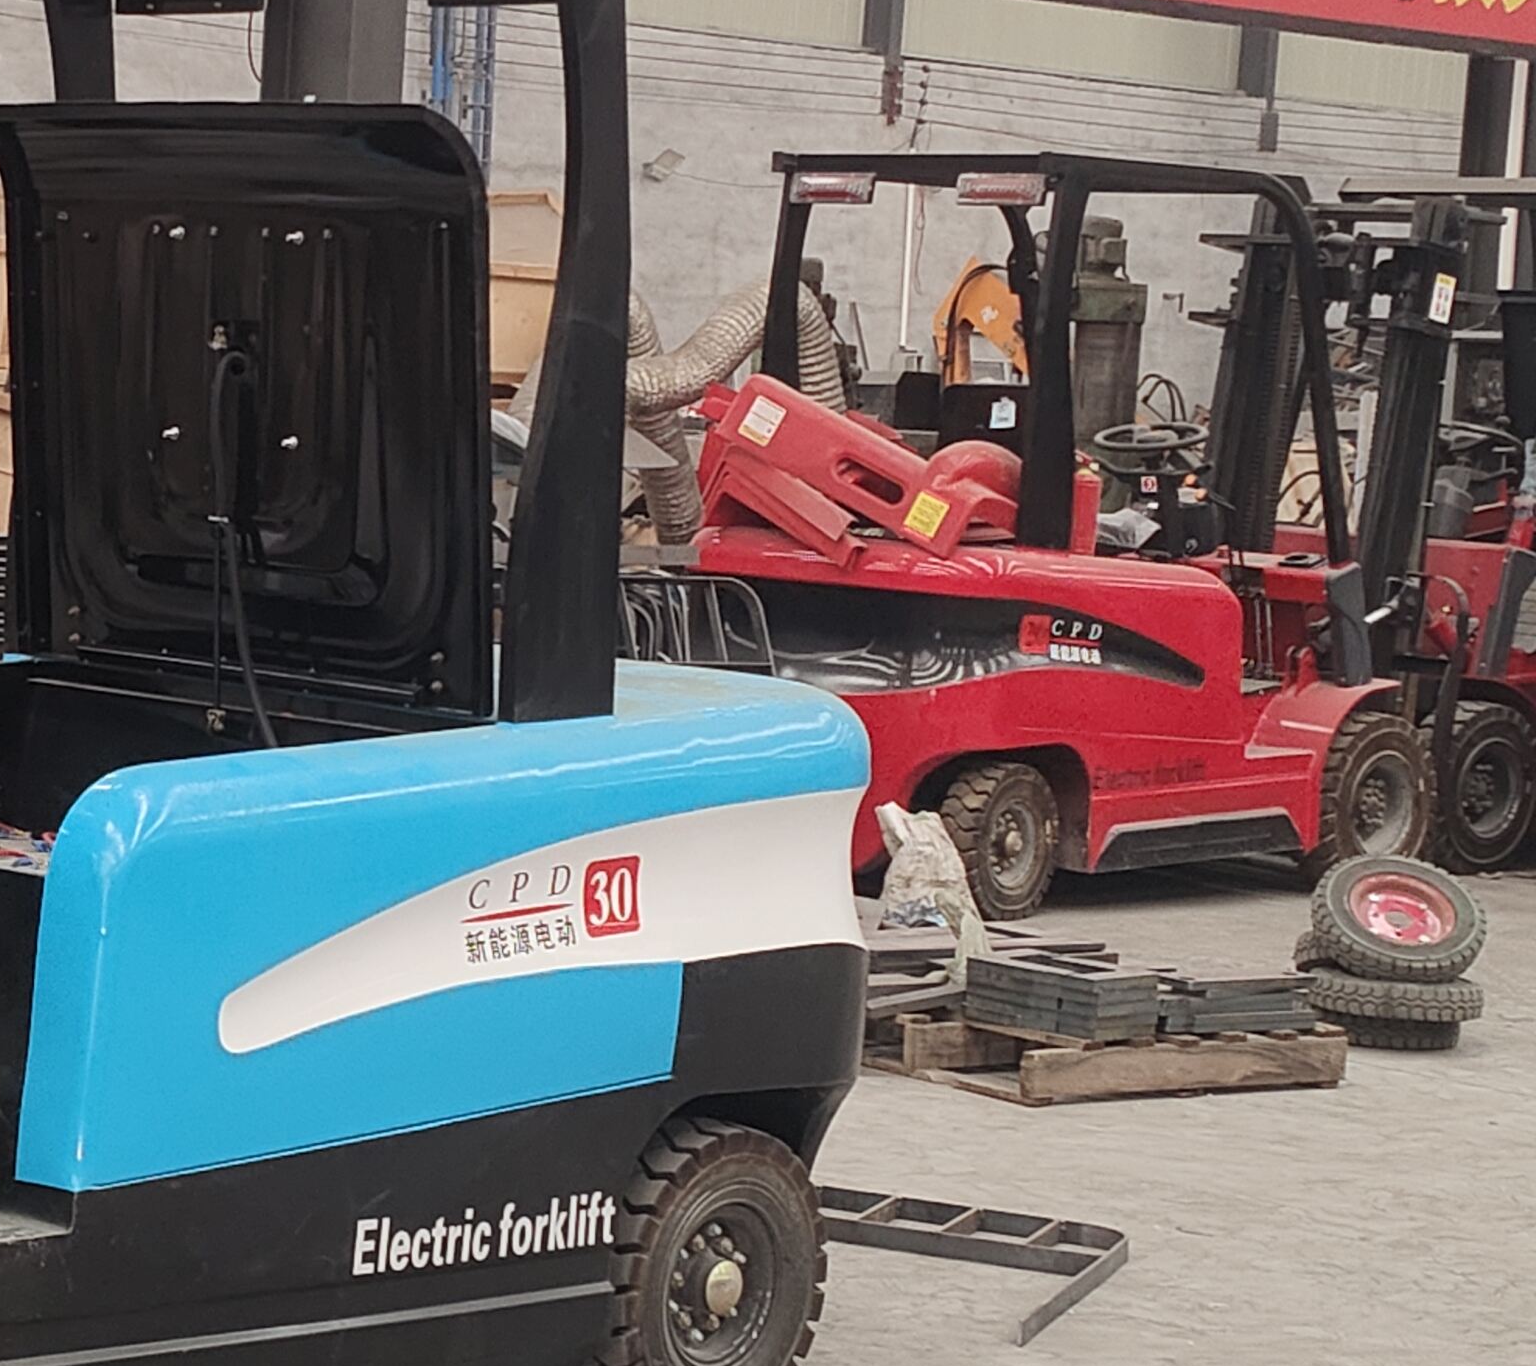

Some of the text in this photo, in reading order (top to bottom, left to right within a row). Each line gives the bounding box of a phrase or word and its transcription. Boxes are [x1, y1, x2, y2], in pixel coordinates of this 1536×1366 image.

[589, 867, 633, 927] 30
[464, 915, 577, 964] 新能源电动
[351, 1191, 617, 1276] Electric forklift
